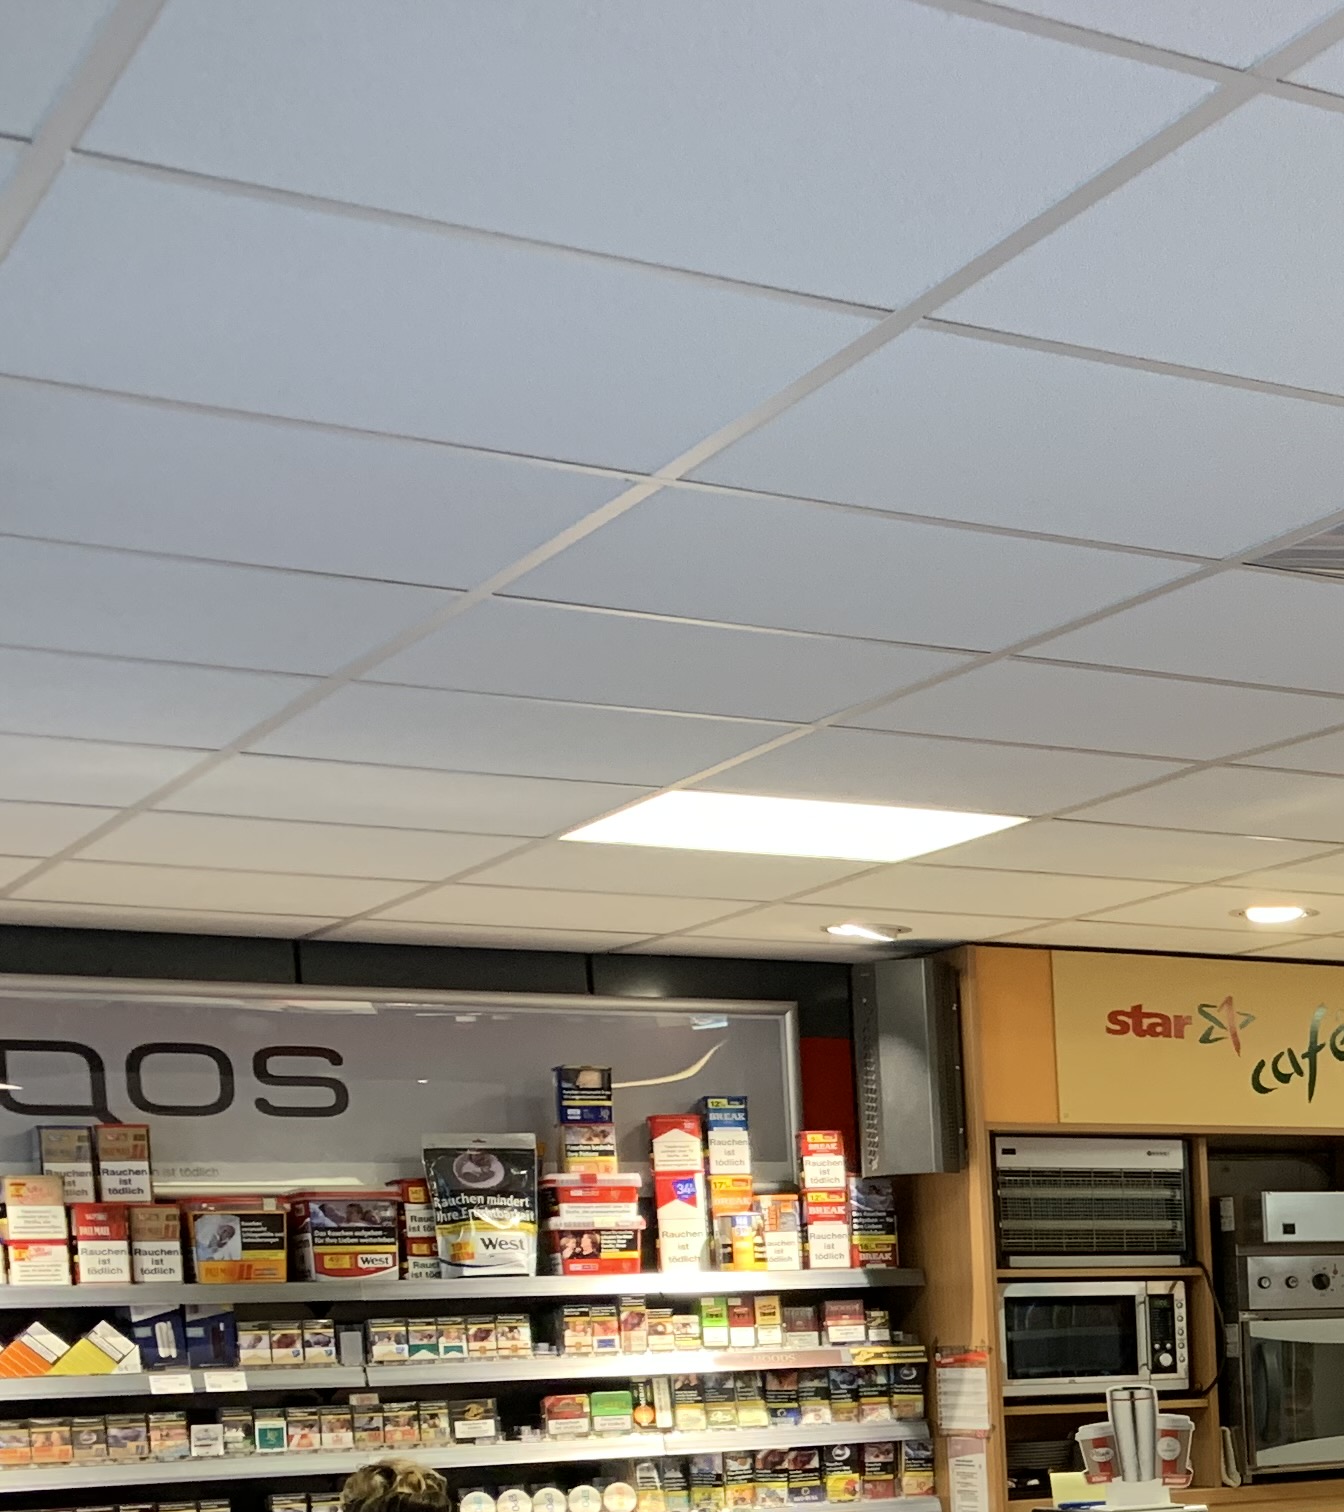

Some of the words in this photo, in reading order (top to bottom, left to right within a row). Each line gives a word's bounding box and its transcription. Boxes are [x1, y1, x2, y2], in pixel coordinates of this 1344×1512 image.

[1106, 1003, 1192, 1040] star
[102, 1168, 148, 1179] Rauchen
[119, 1178, 132, 1186] ist
[108, 1185, 145, 1196] tödlich
[486, 1196, 530, 1207] mindert
[480, 1236, 526, 1251] West
[80, 1248, 127, 1258] Rauchen
[134, 1248, 179, 1259] Rauchen
[361, 1255, 389, 1268] West
